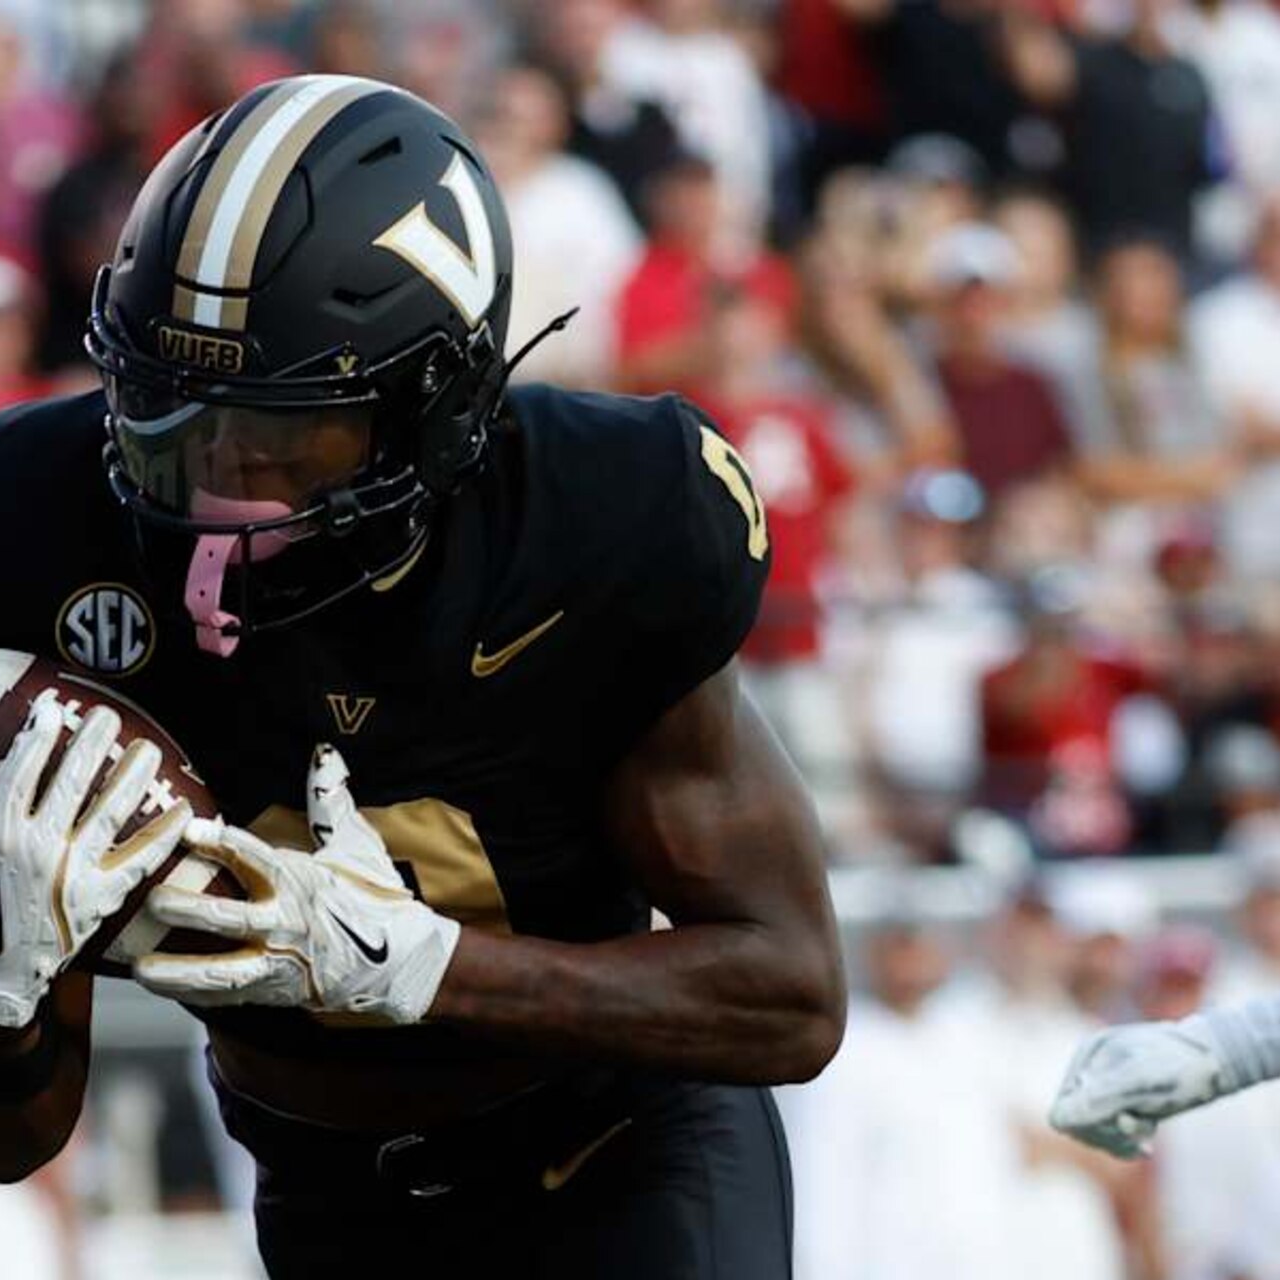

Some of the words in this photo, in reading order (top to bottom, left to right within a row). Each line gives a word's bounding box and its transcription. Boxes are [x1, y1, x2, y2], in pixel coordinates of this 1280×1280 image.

[373, 150, 496, 329] V
[158, 325, 244, 376] VUFB
[66, 589, 147, 669] SEC
[326, 694, 376, 734] V
